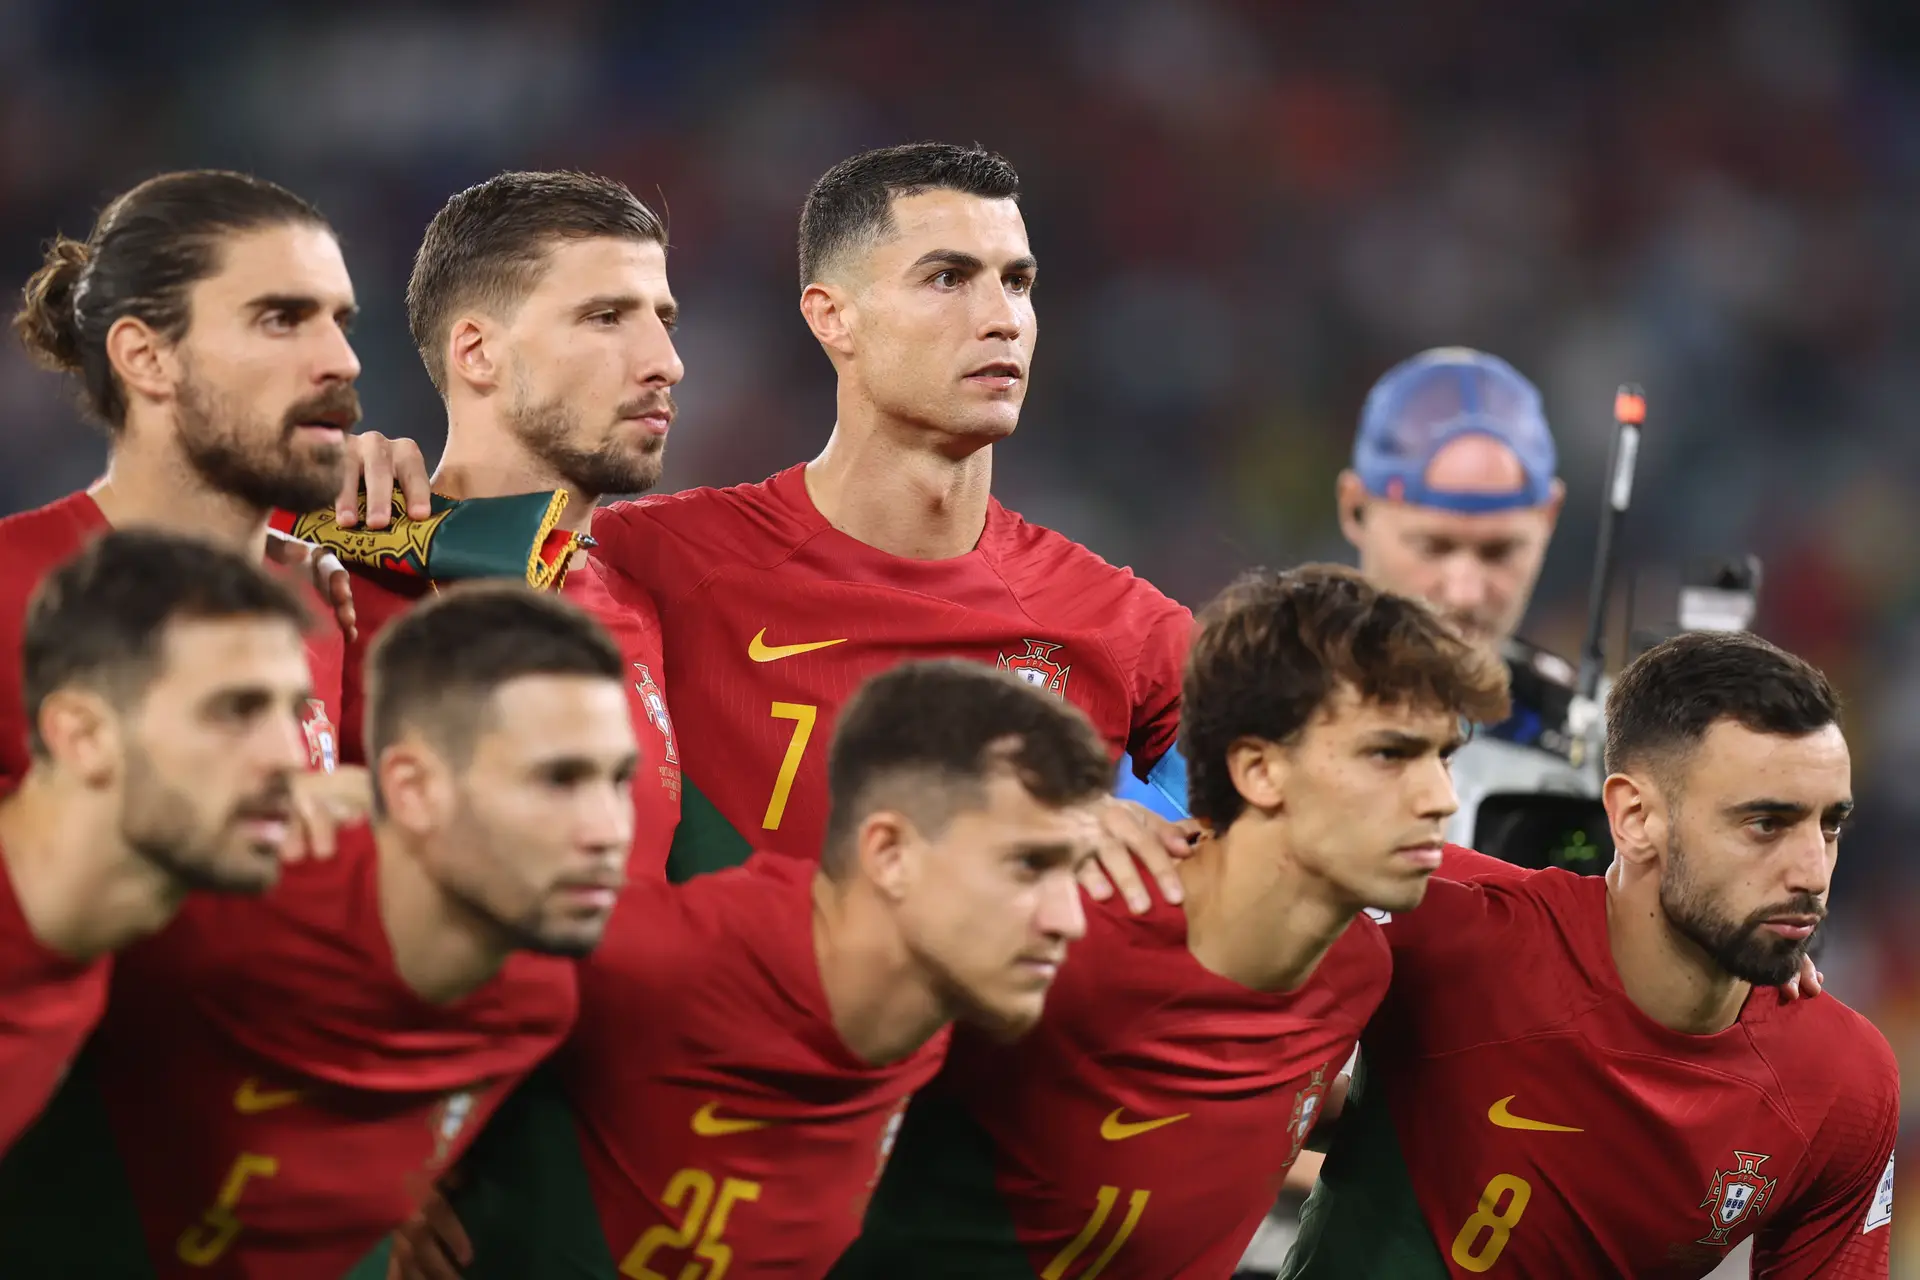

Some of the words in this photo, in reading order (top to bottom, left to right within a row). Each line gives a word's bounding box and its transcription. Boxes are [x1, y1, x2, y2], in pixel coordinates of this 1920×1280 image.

[762, 701, 817, 830] 7
[177, 1152, 279, 1266] 5
[618, 1168, 762, 1280] 25
[1040, 1185, 1151, 1280] 11
[1452, 1173, 1532, 1273] 8
